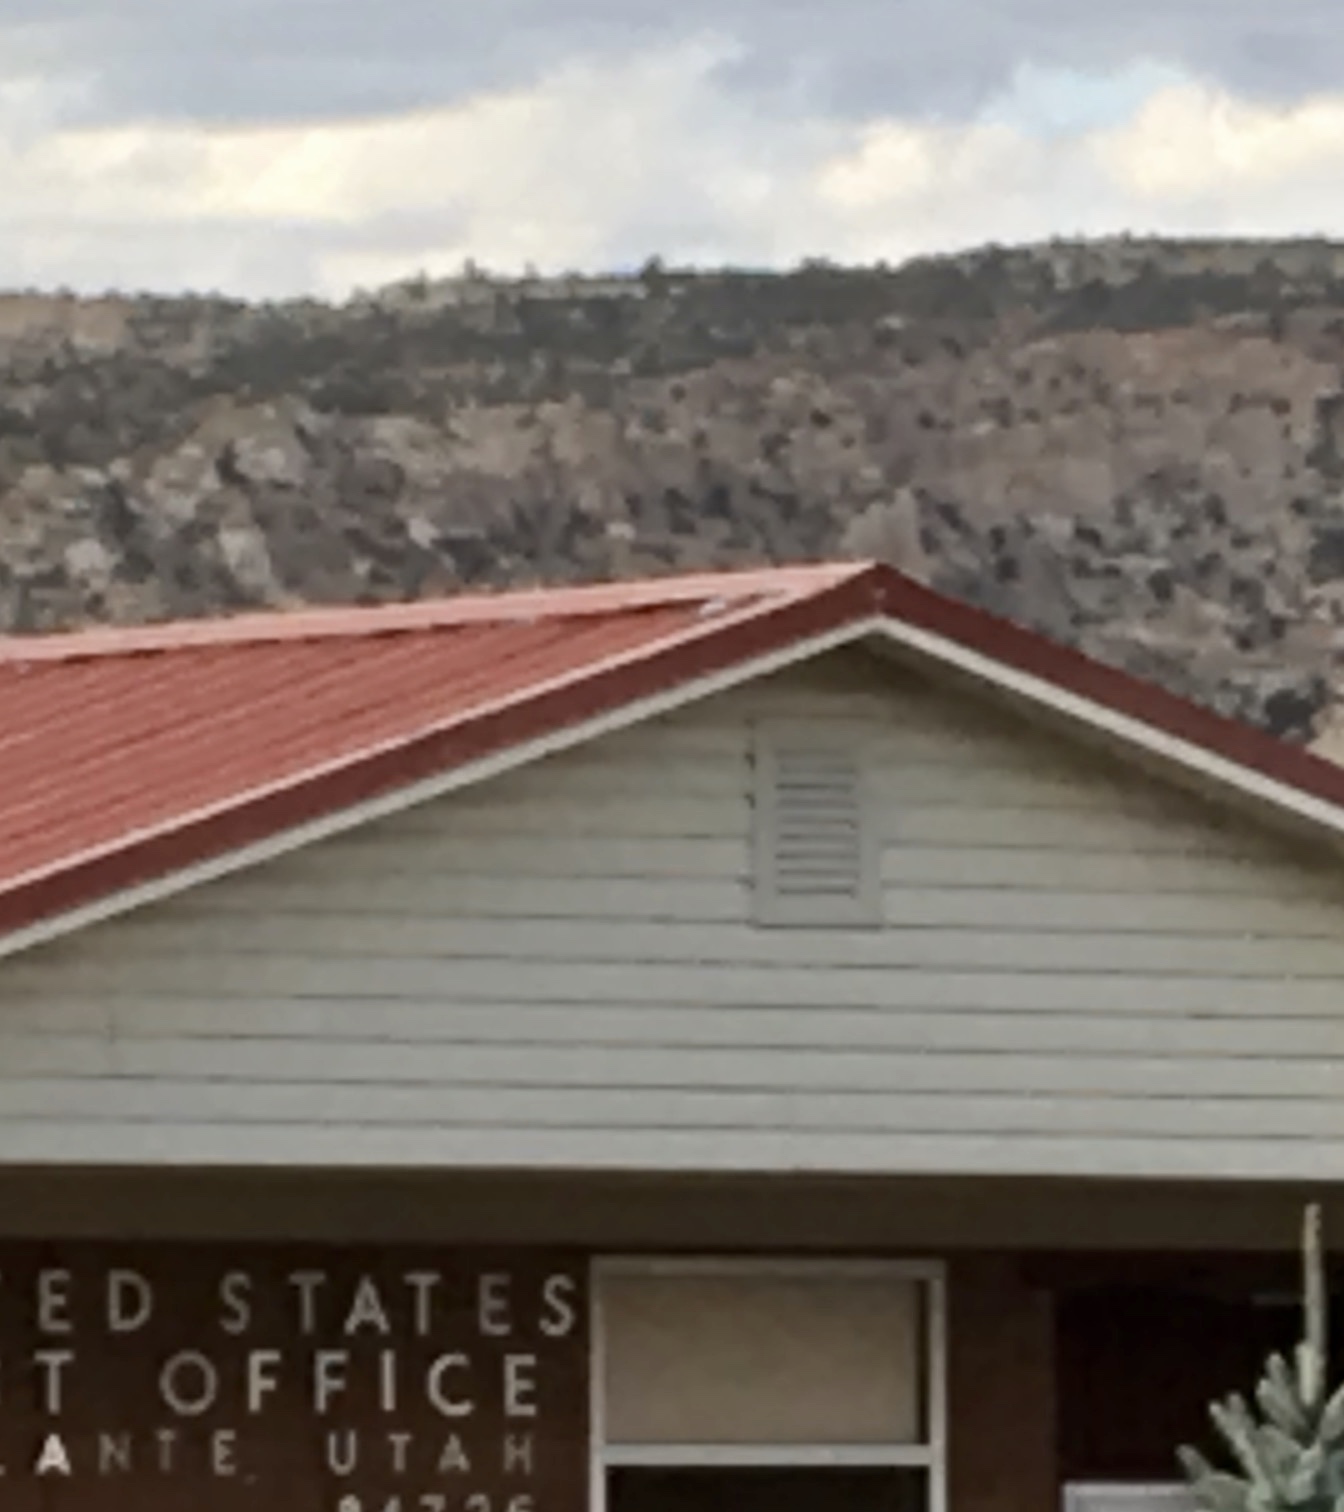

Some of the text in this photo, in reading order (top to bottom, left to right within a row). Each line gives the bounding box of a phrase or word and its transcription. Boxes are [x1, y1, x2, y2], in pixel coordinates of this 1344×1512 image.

[219, 1271, 577, 1337] STATES
[159, 1349, 538, 1418] OFFICE
[327, 1429, 535, 1477] UTAH
